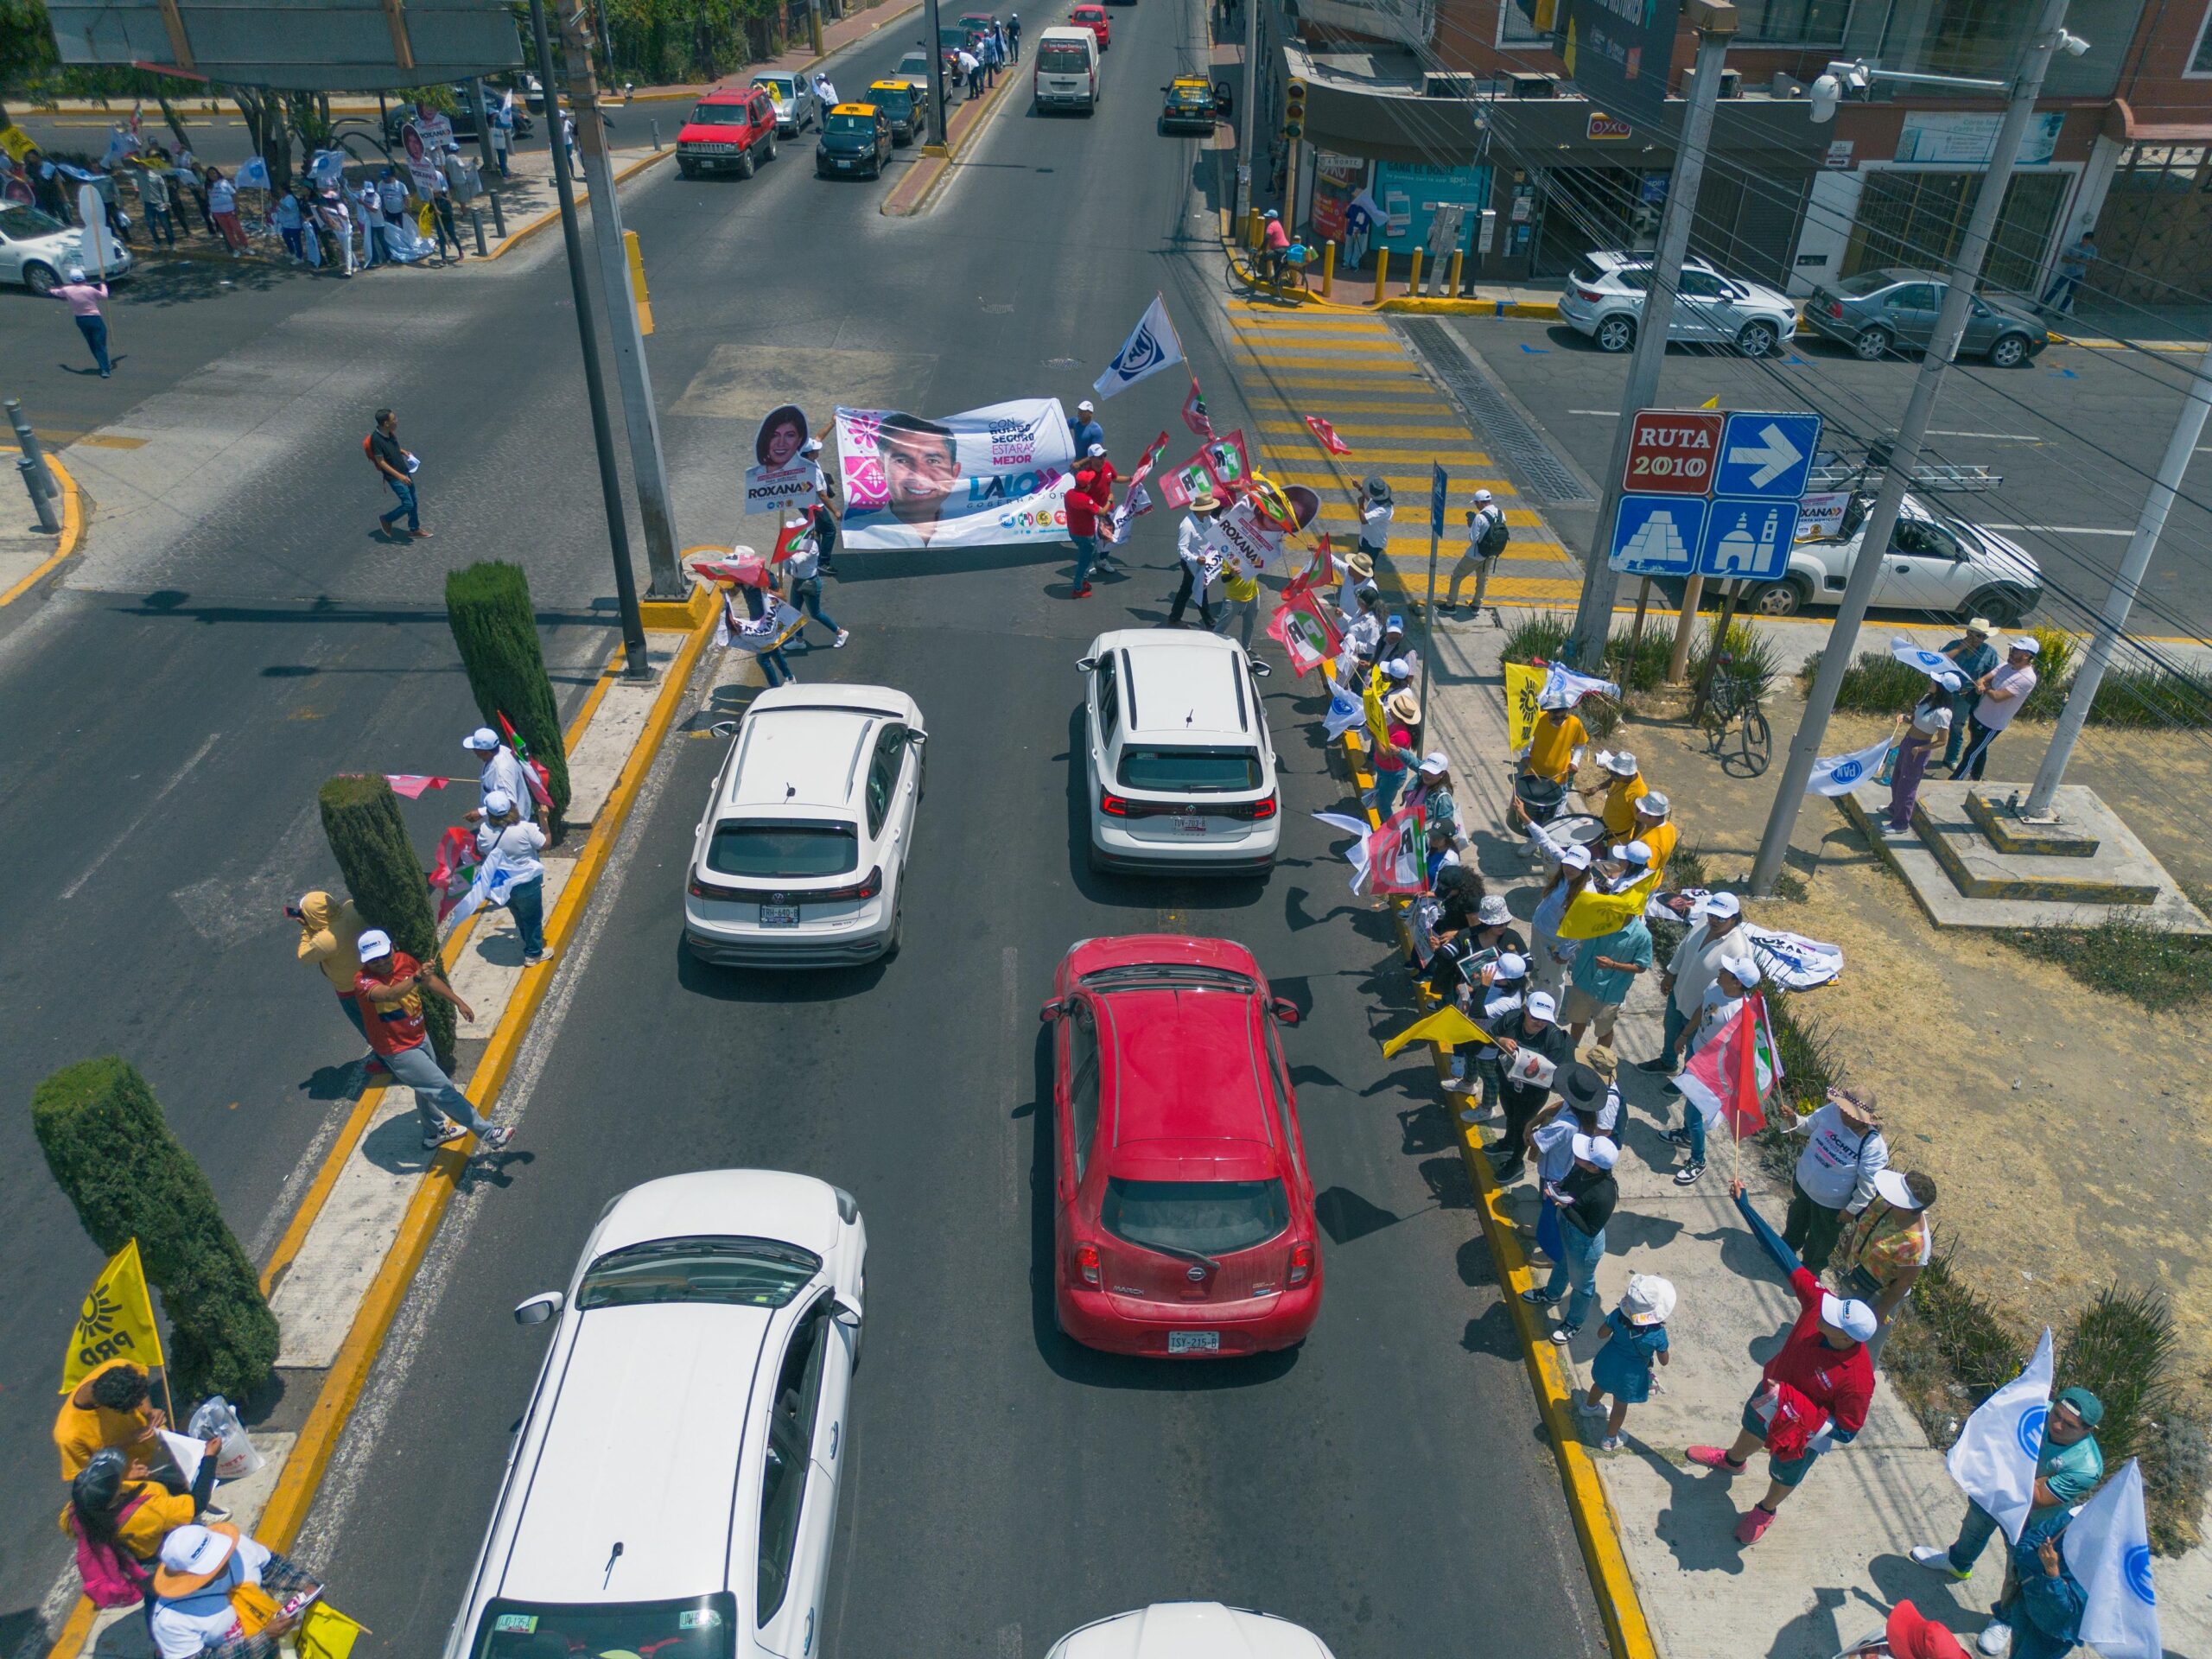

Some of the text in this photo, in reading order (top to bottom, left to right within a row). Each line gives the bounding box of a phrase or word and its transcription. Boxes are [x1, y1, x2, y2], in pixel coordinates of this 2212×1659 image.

[1592, 121, 1629, 135] OXXO
[989, 418, 1015, 429] CON
[992, 433, 1034, 443] SEGURO
[1638, 429, 1711, 448] RUTA
[994, 454, 1032, 466] MEJOR
[1633, 456, 1707, 477] 2010
[748, 483, 803, 499] ROXANA
[969, 472, 1040, 501] LALO
[1219, 519, 1258, 562] ROXANA
[1836, 764, 1857, 778] PAN
[1113, 1285, 1145, 1294] MARCH
[1171, 1338, 1217, 1348] TSY-215-B
